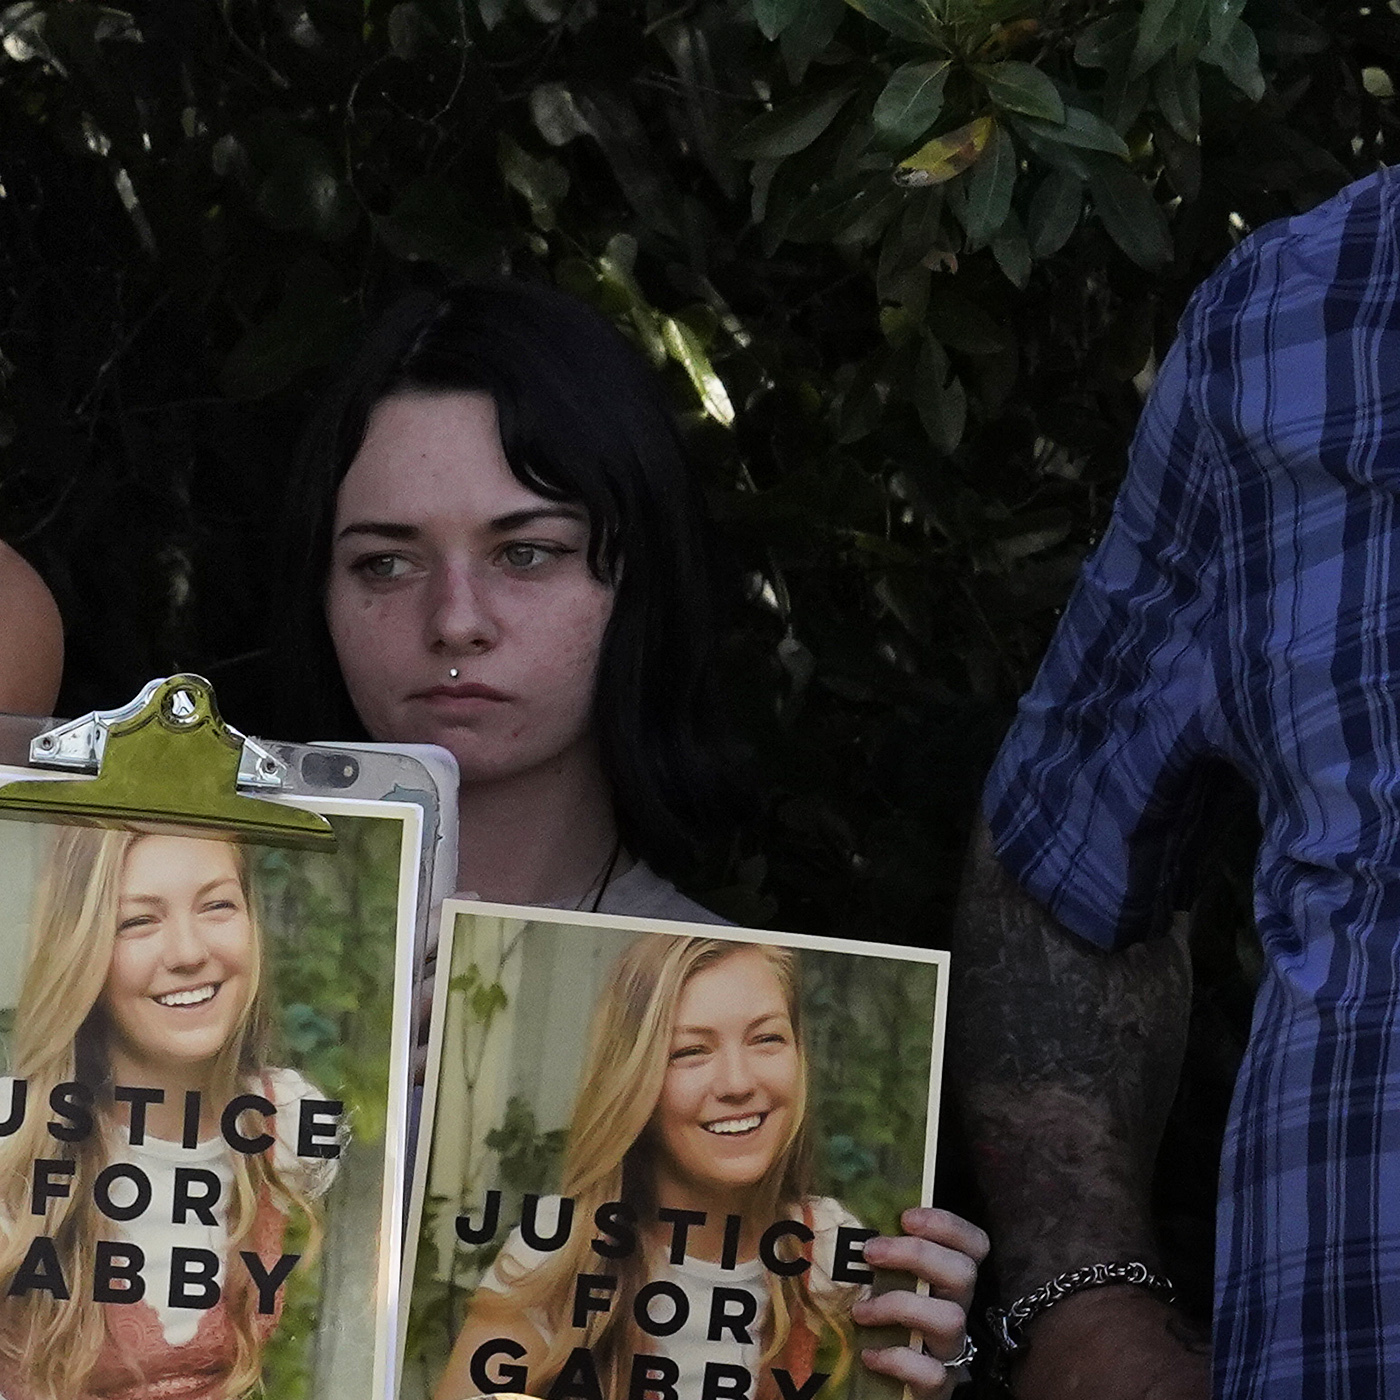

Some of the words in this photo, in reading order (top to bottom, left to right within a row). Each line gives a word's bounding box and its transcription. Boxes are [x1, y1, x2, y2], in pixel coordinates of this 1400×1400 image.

[31, 1158, 223, 1228] FOR
[455, 1190, 880, 1285] JUSTICE
[571, 1273, 758, 1345] FOR
